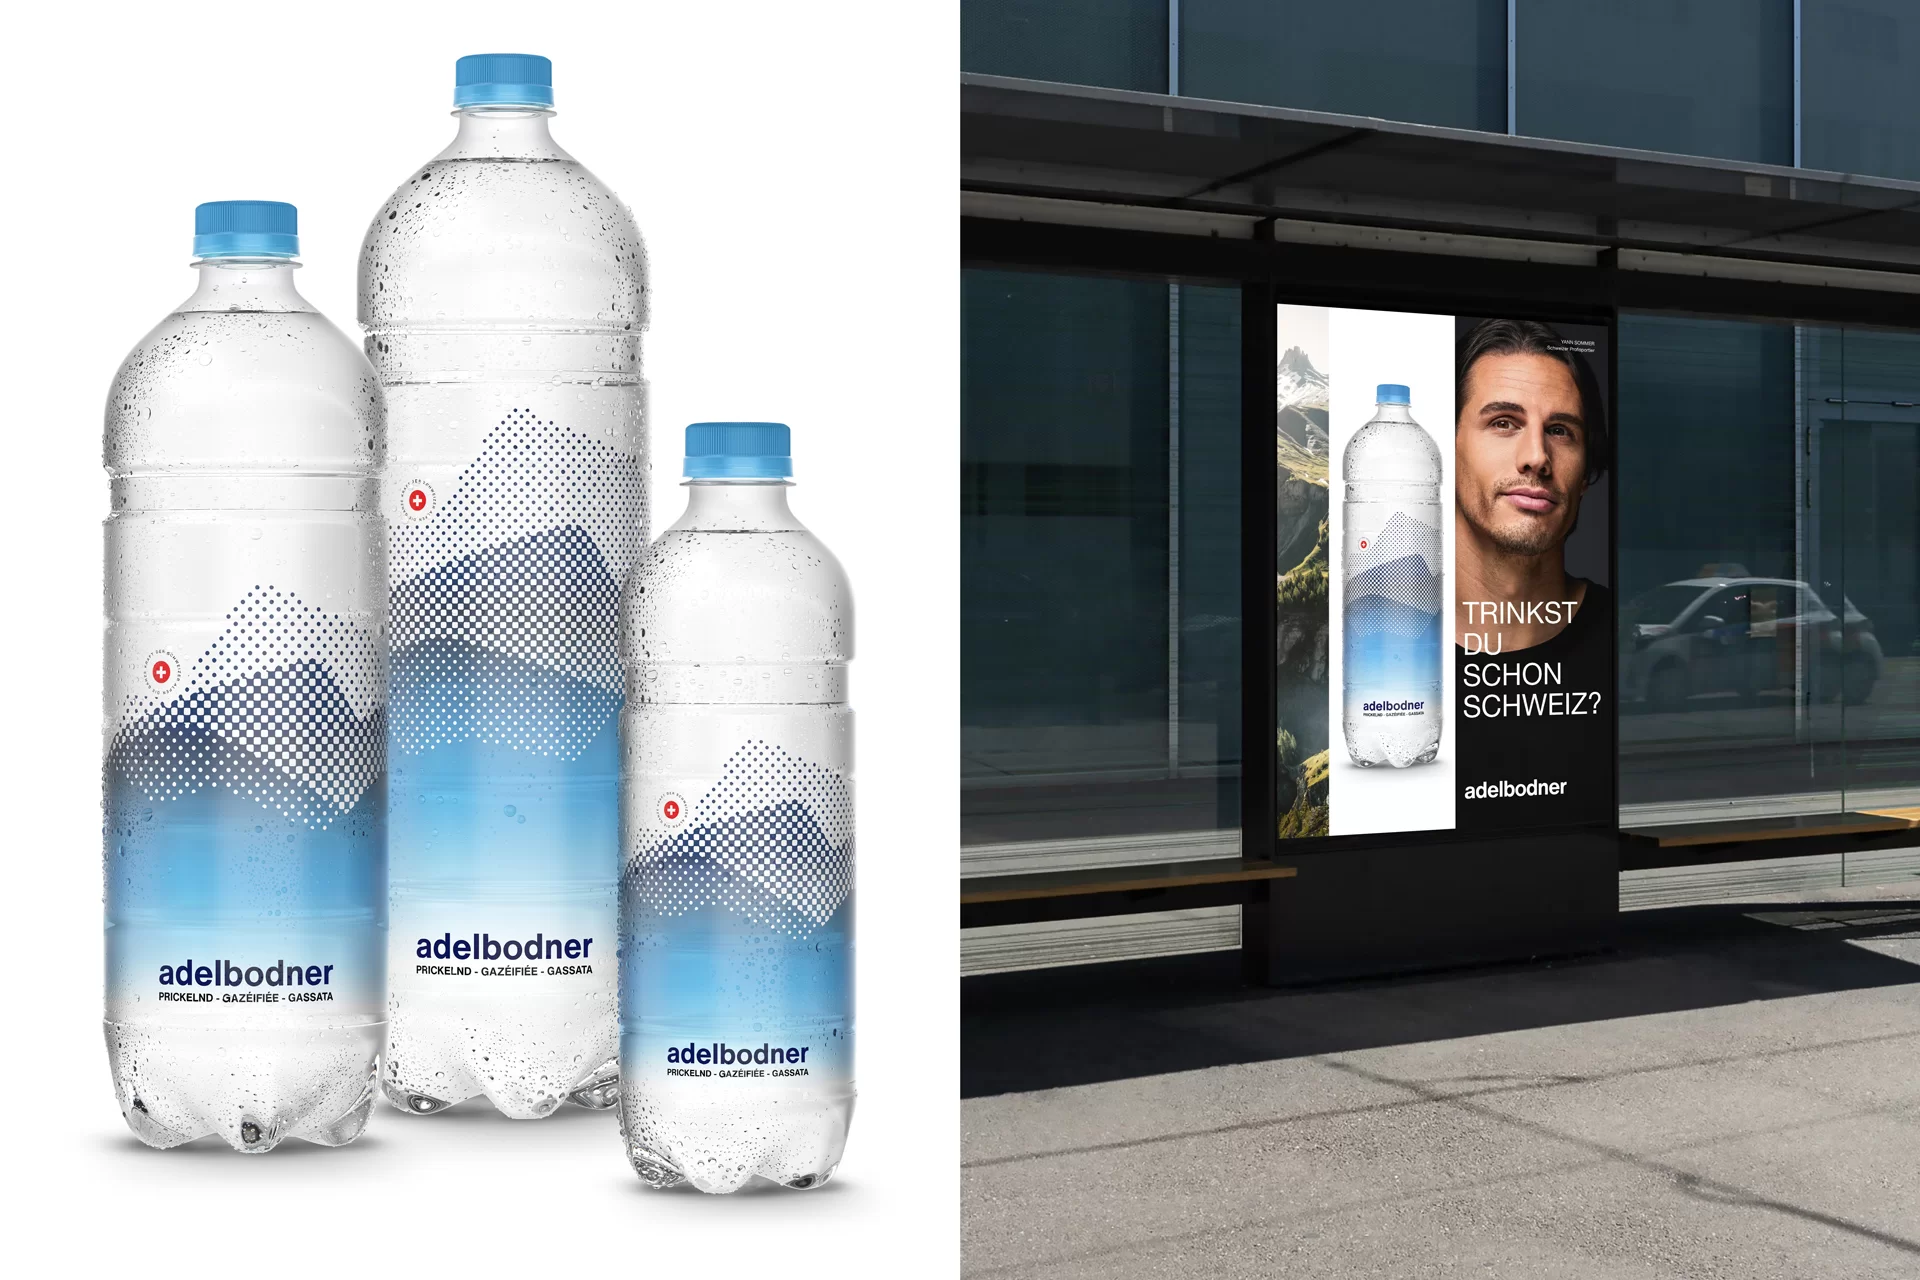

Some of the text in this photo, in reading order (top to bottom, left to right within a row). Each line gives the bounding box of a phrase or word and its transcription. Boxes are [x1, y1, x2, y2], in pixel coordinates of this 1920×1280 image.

[1462, 601, 1578, 625] TRINKST
[1464, 632, 1502, 656] DU
[1463, 662, 1561, 688] SCHON
[1363, 700, 1424, 711] adelbodner
[1463, 691, 1602, 718] SCHWEIZ?
[1464, 778, 1568, 800] adelbodner
[416, 932, 592, 960] adelbodner
[158, 960, 334, 986] adelbodner
[416, 965, 472, 976] PRICKELND
[481, 964, 538, 976] GAZÉIFIÉE
[547, 965, 592, 975] GASSATA
[158, 992, 213, 1002] PRICKELND
[222, 992, 279, 1003] GAZÉIFIÉE
[288, 992, 334, 1002] GASSATA
[667, 1042, 809, 1064] adelbodner
[667, 1068, 712, 1077] PRICKELND
[718, 1068, 764, 1078] GAZÉIFIÉE
[772, 1068, 809, 1077] GASSATA
